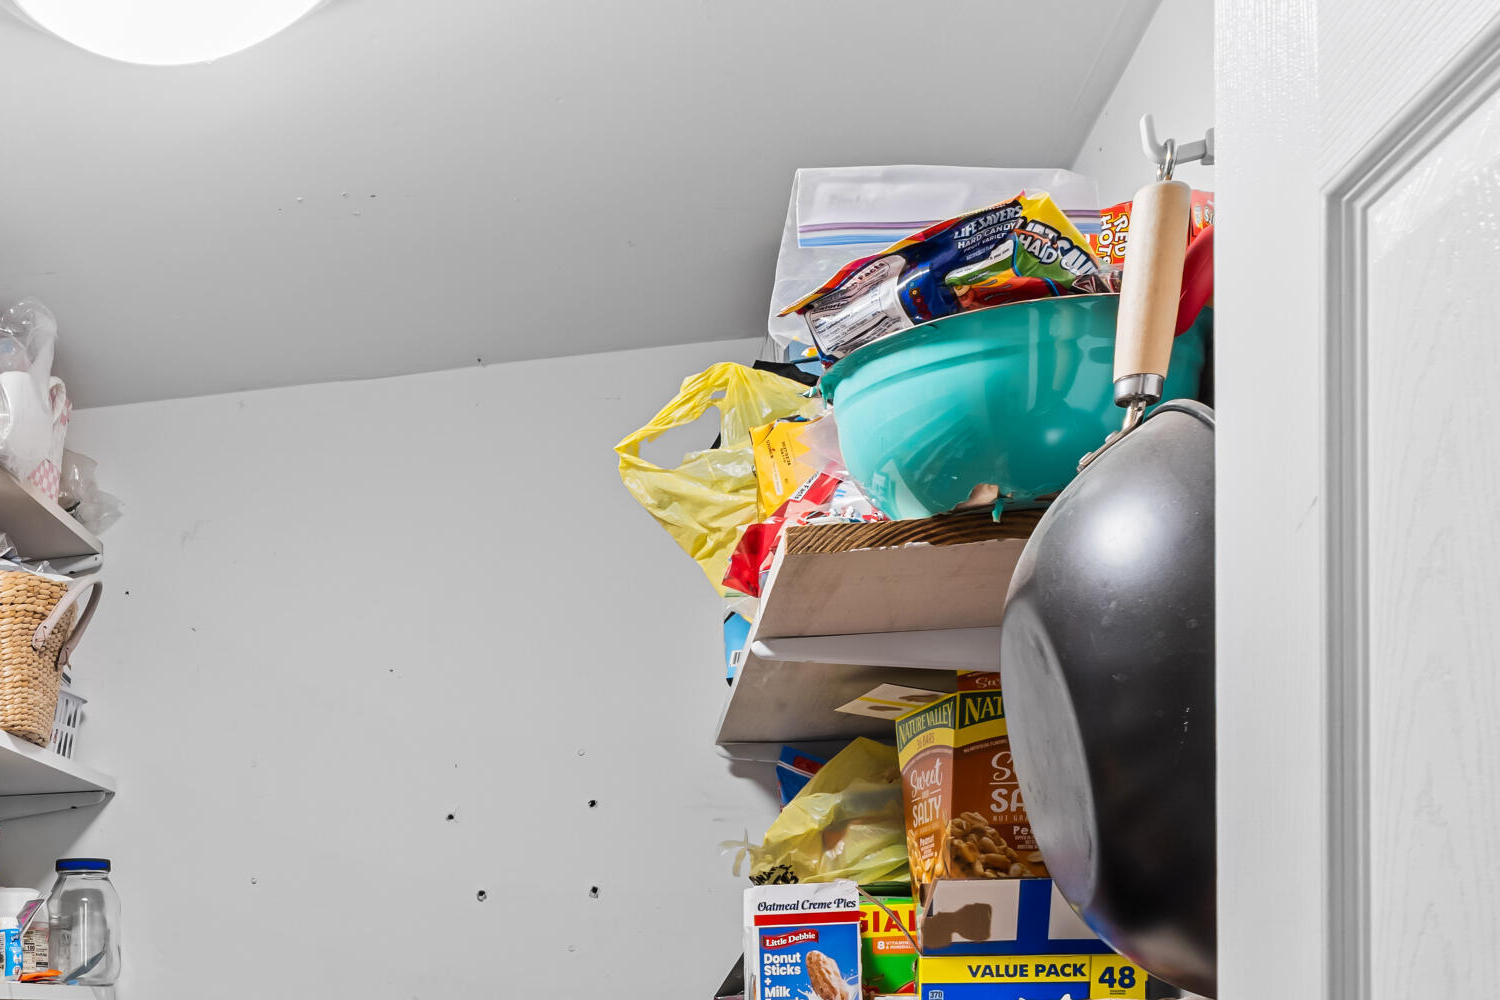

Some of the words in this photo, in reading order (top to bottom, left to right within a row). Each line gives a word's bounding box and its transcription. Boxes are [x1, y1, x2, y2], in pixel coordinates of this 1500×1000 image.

[981, 205, 1022, 229] SAVERS
[957, 233, 982, 249] HARD
[982, 222, 1015, 238] CANDY
[1113, 213, 1129, 257] RED
[899, 713, 926, 748] NATURE
[926, 702, 954, 726] VALLEY
[910, 758, 943, 797] Sweet
[912, 795, 942, 828] SALTY
[757, 900, 800, 913] Oatmeal
[802, 899, 832, 911] Creme
[834, 897, 857, 909] Pies
[765, 935, 787, 947] Little
[788, 931, 816, 944] Debbie
[877, 940, 885, 950] 8
[764, 951, 802, 965] Donut
[764, 965, 801, 976] Sticks
[967, 963, 1029, 979] VALUE
[1034, 962, 1087, 977] PACK
[1098, 965, 1137, 989] 48
[764, 986, 790, 997] Milk
